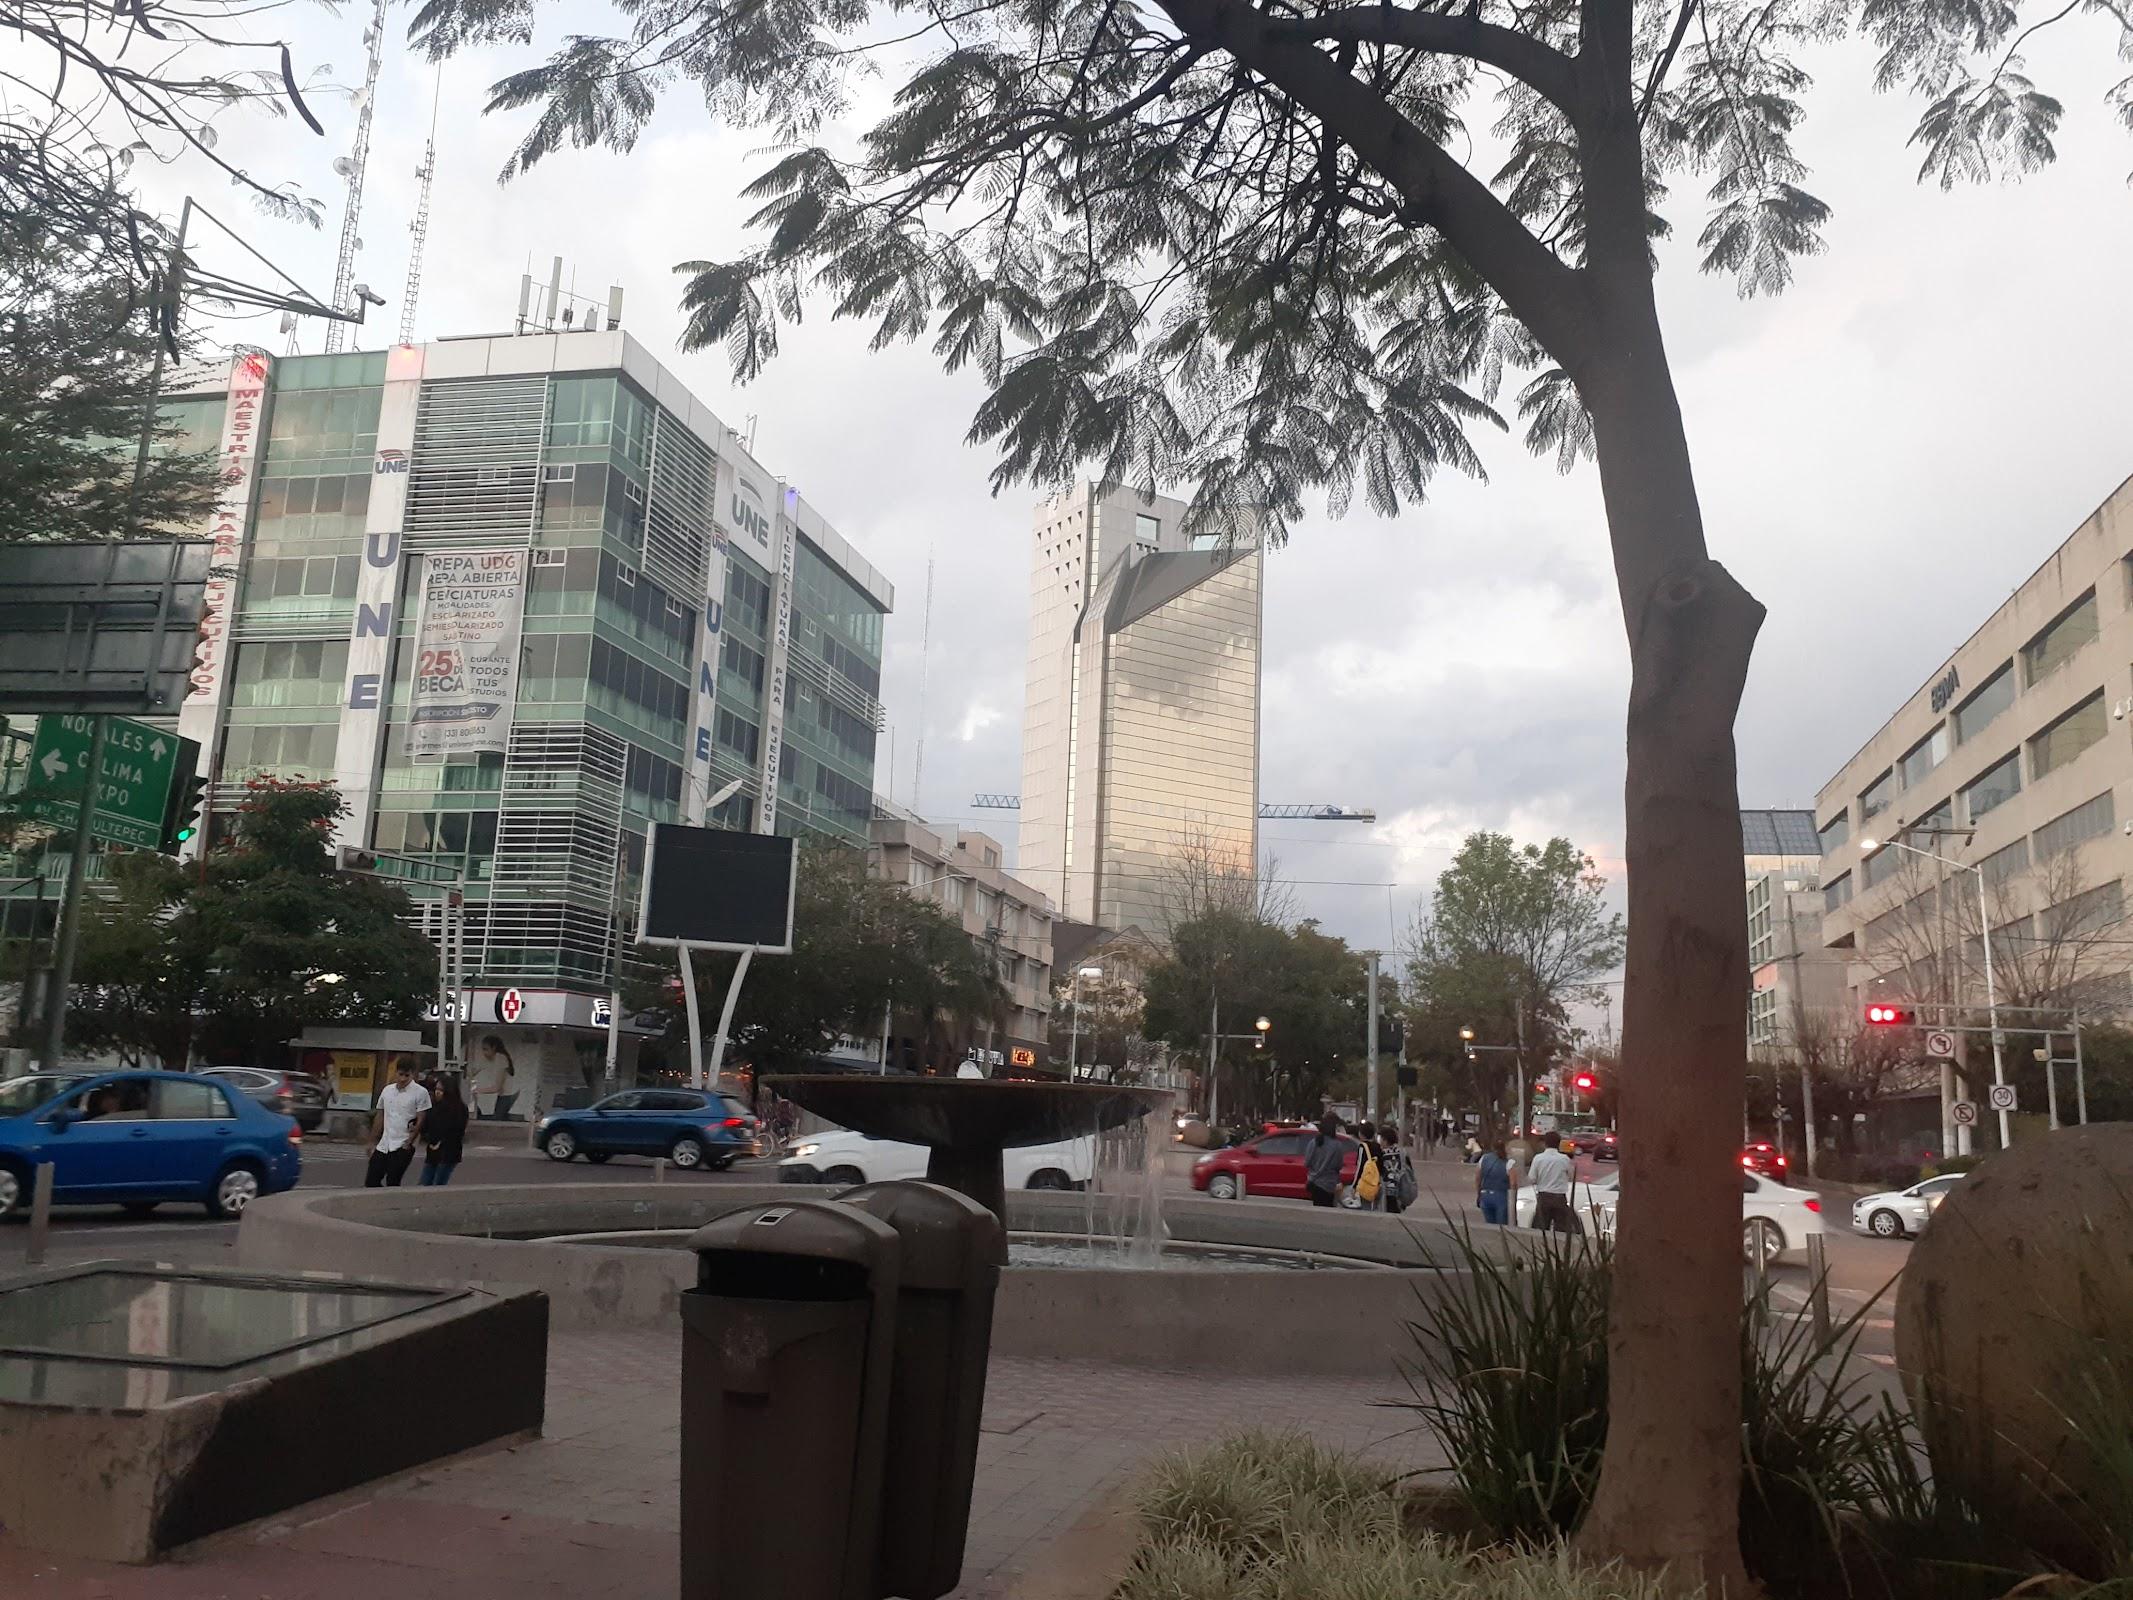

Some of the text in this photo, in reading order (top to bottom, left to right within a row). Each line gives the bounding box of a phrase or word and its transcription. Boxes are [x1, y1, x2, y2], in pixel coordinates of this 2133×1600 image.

[375, 460, 409, 474] UNE
[732, 493, 769, 549] UNE
[712, 534, 727, 556] UNE
[428, 555, 516, 571] REPA UDG
[427, 571, 518, 585] REPA ABIERTA
[349, 533, 400, 709] UNE
[470, 666, 509, 676] TODOS
[476, 678, 498, 687] TUS
[696, 598, 722, 763] UNE
[418, 675, 465, 694] BECA
[470, 687, 507, 697] STUDIOS
[773, 666, 783, 706] PARA
[61, 715, 144, 752] NOLES
[77, 751, 143, 785] CLIMA
[764, 724, 778, 823] EJECUTIVOS
[97, 783, 129, 806] XPO
[57, 809, 147, 842] CHULTEPEC
